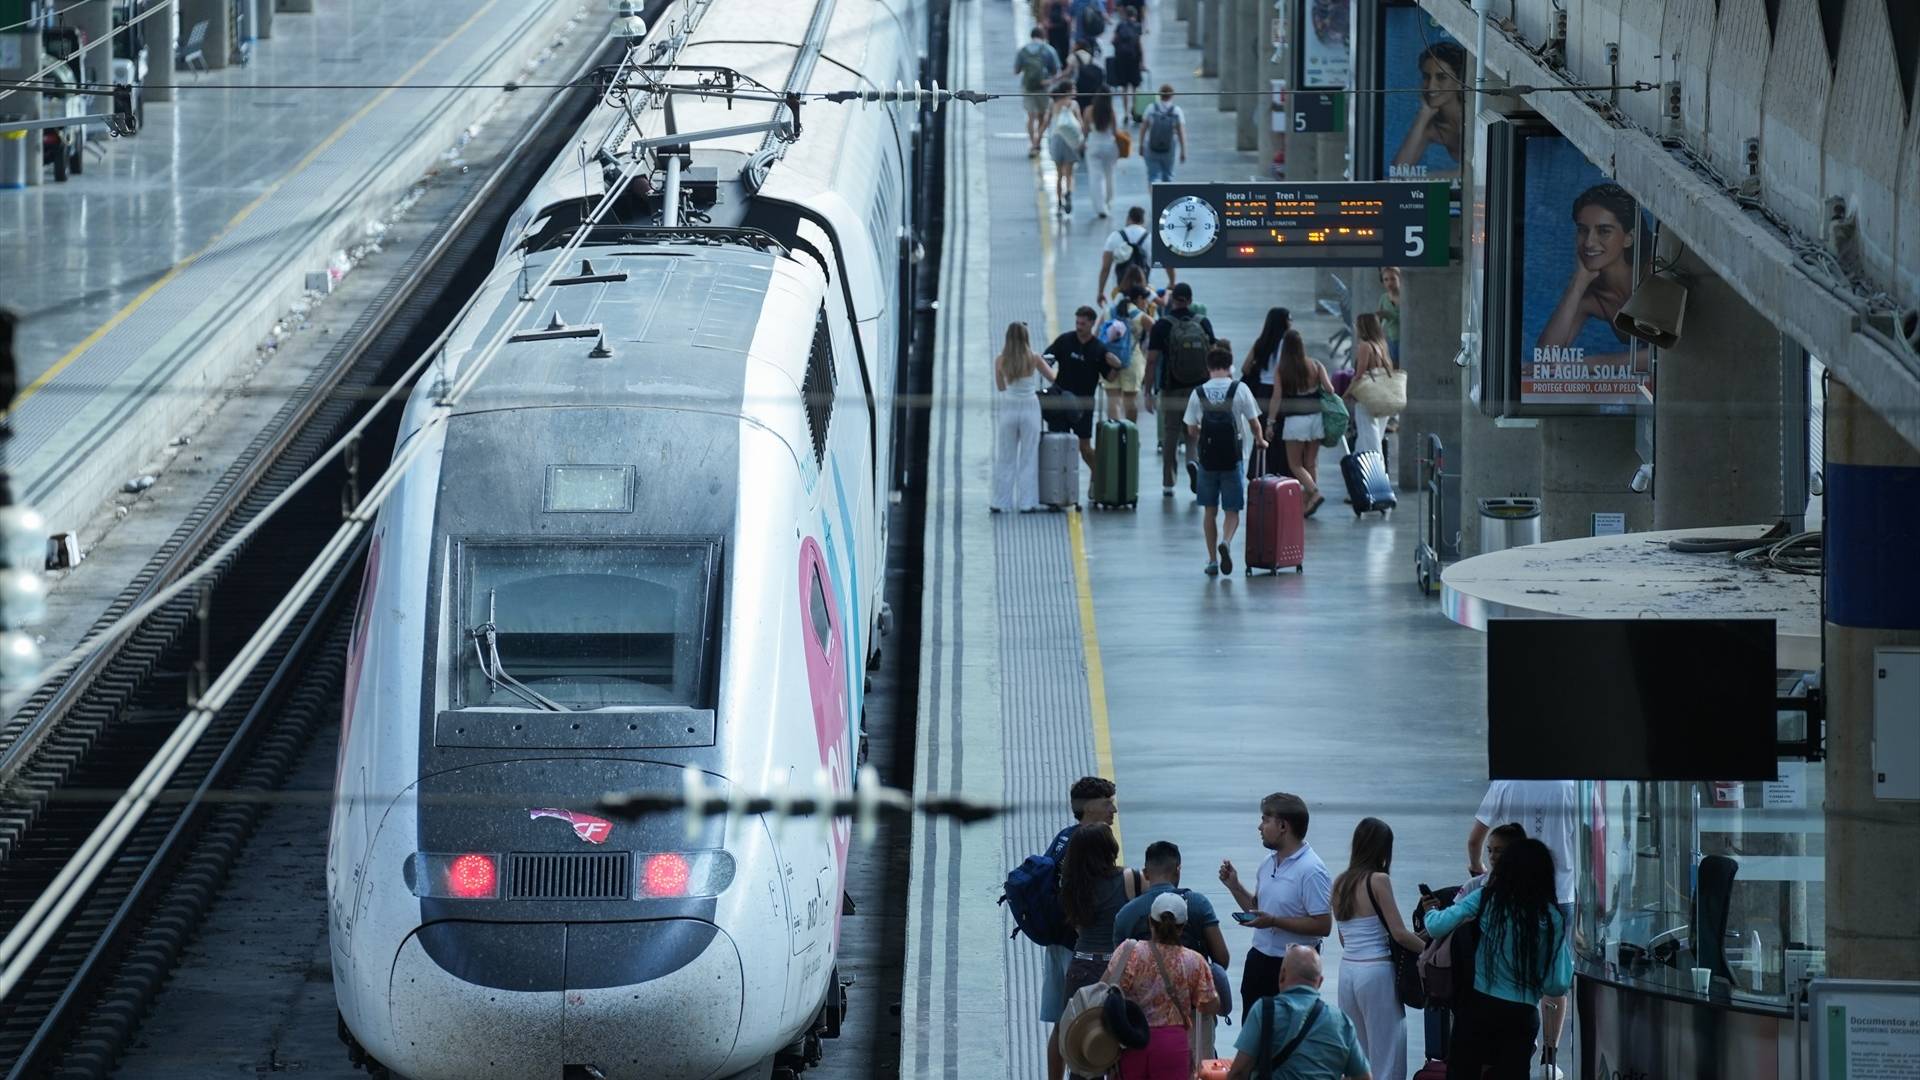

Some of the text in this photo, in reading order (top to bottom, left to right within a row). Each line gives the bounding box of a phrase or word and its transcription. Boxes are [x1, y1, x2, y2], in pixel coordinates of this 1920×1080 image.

[1295, 112, 1306, 131] 5
[1275, 192, 1295, 200] Tren
[1411, 190, 1424, 199] Vía
[1226, 218, 1257, 227] Destino
[1405, 226, 1425, 257] 5
[1533, 345, 1585, 363] BÁÑATE
[1533, 365, 1554, 380] EN
[1555, 365, 1590, 380] AGUA
[1533, 383, 1563, 393] PROTEGE
[1564, 383, 1593, 394] CUERPO,
[1594, 383, 1612, 393] CARA
[1613, 383, 1618, 393] Y
[1850, 1016, 1906, 1026] Documentos
